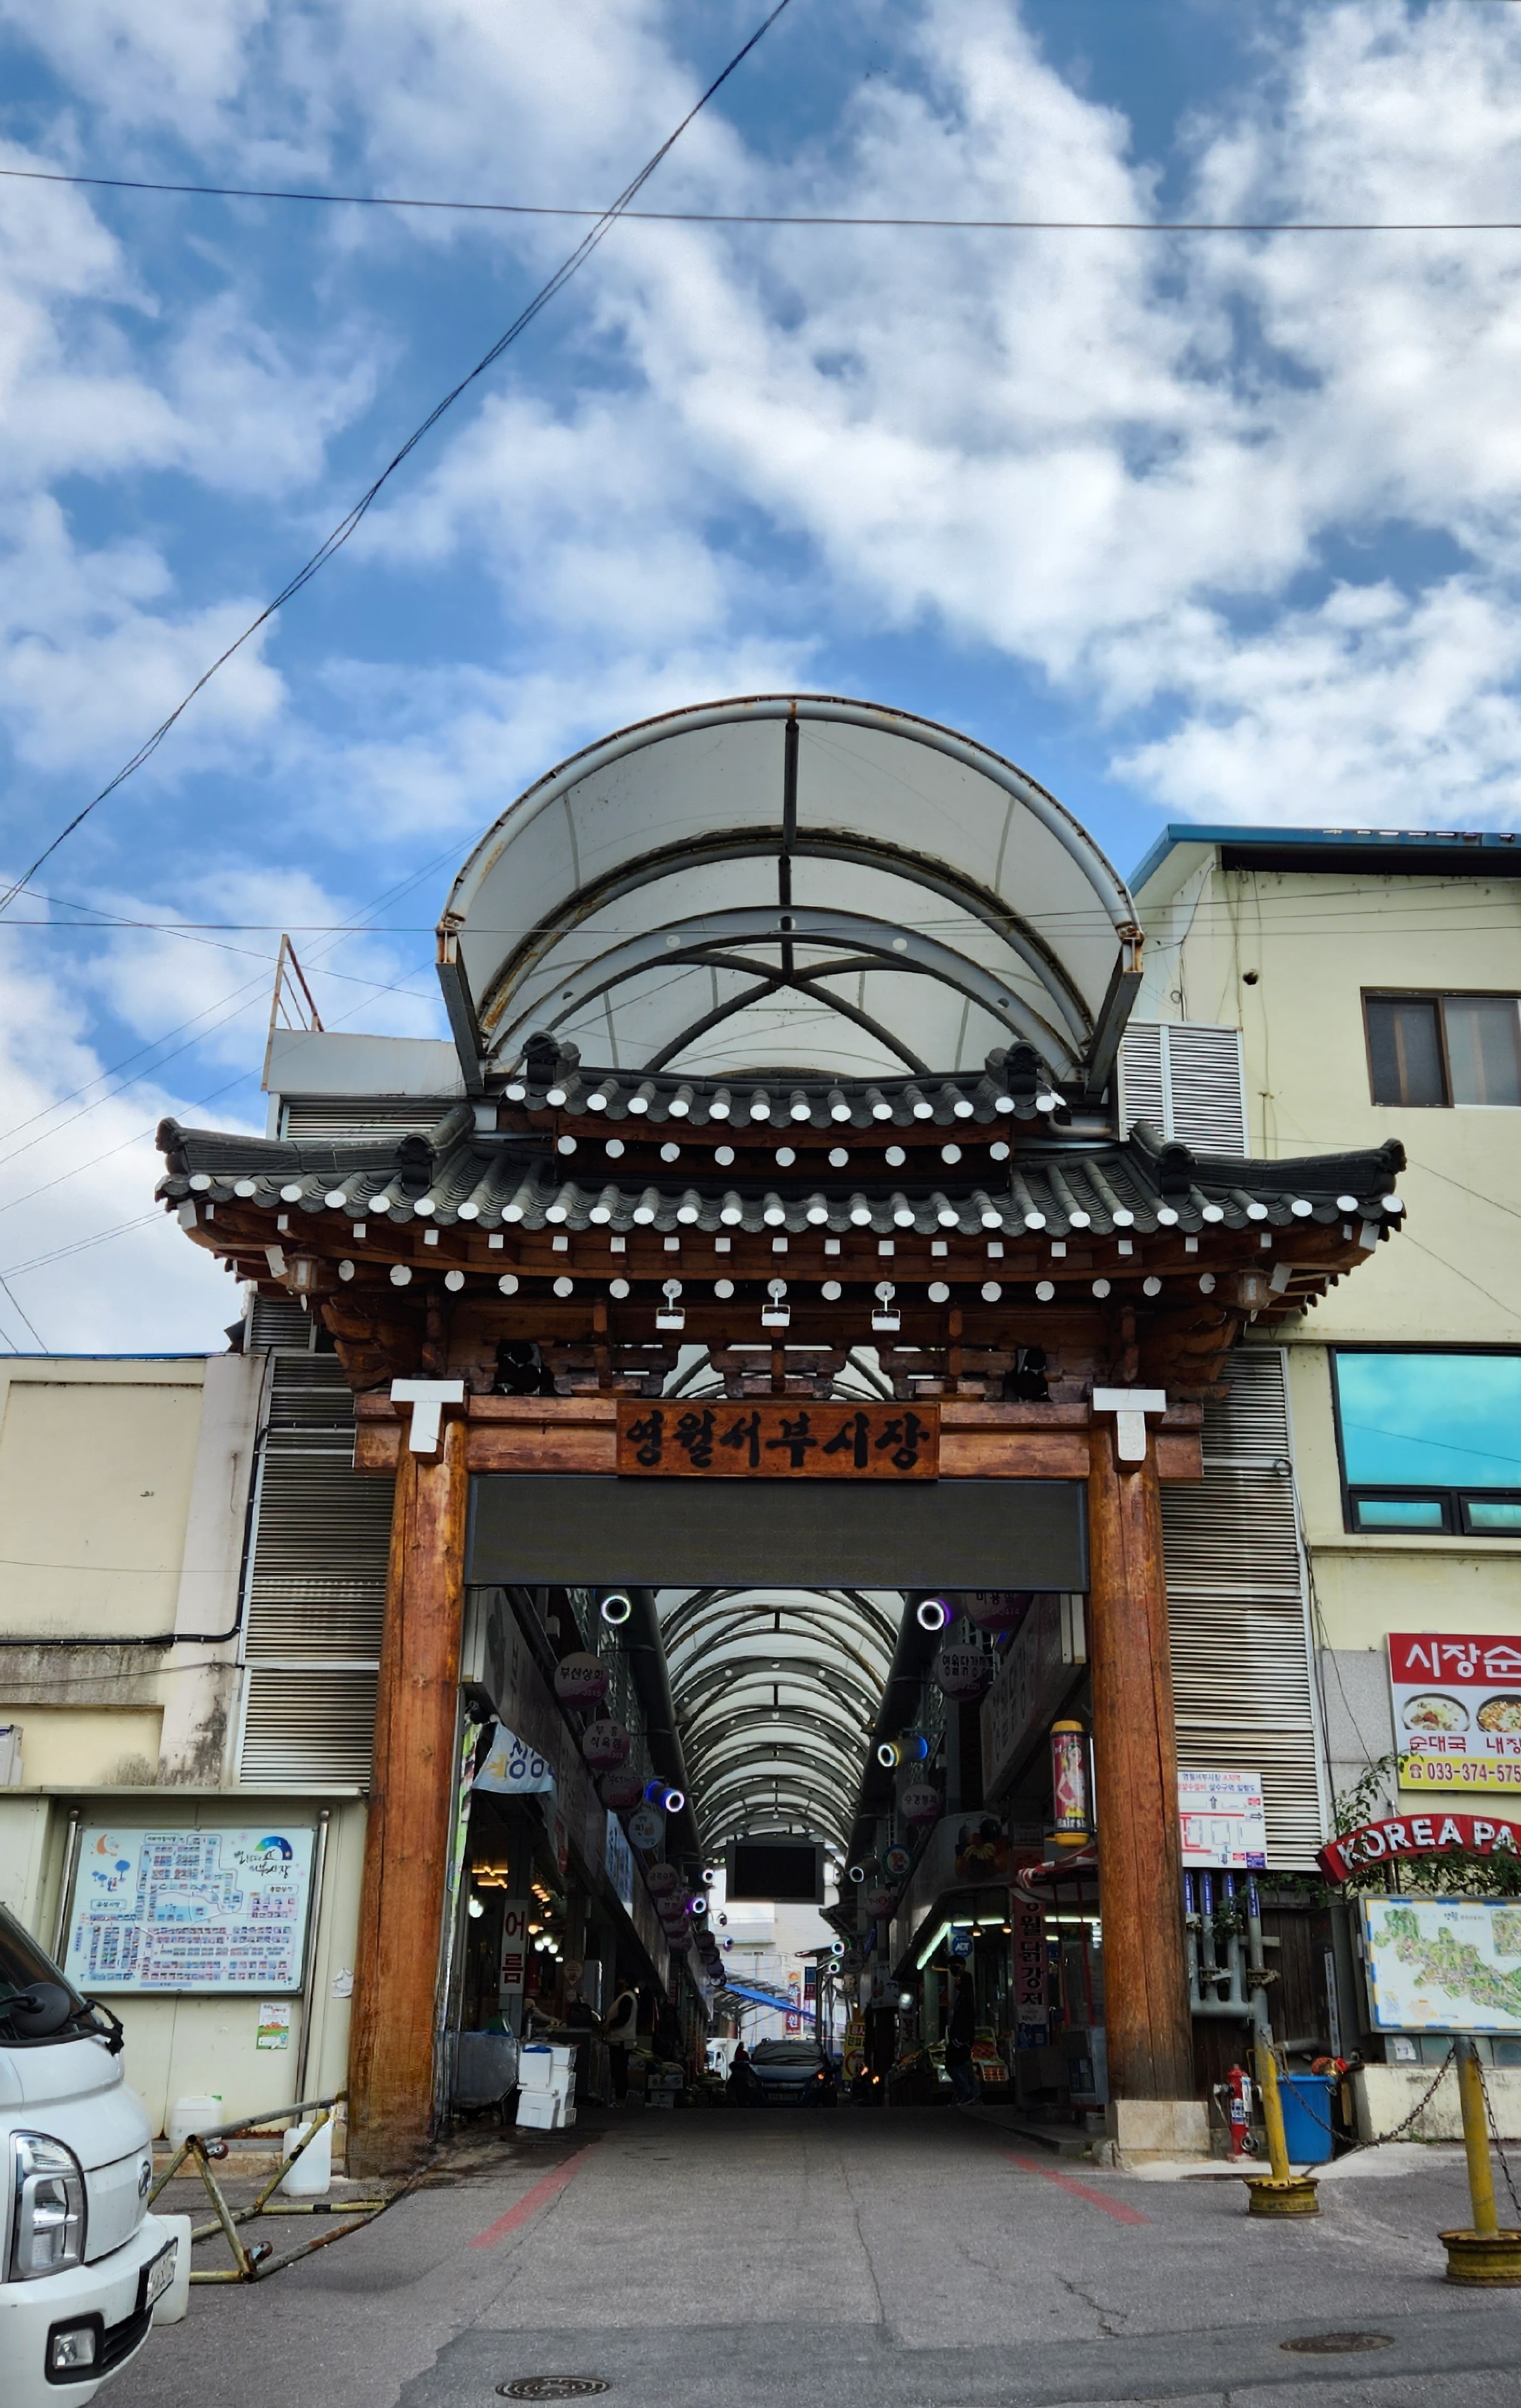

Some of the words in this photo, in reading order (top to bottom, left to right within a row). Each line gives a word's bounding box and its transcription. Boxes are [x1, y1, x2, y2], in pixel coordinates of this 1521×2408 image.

[626, 1408, 929, 1470] 영월서부시장
[561, 1667, 604, 1682] 부산상회
[1409, 1736, 1466, 1753] 순대국
[1337, 1818, 1463, 1870] KOREA
[1474, 1821, 1521, 1855] PA
[501, 1911, 525, 1984] 어름
